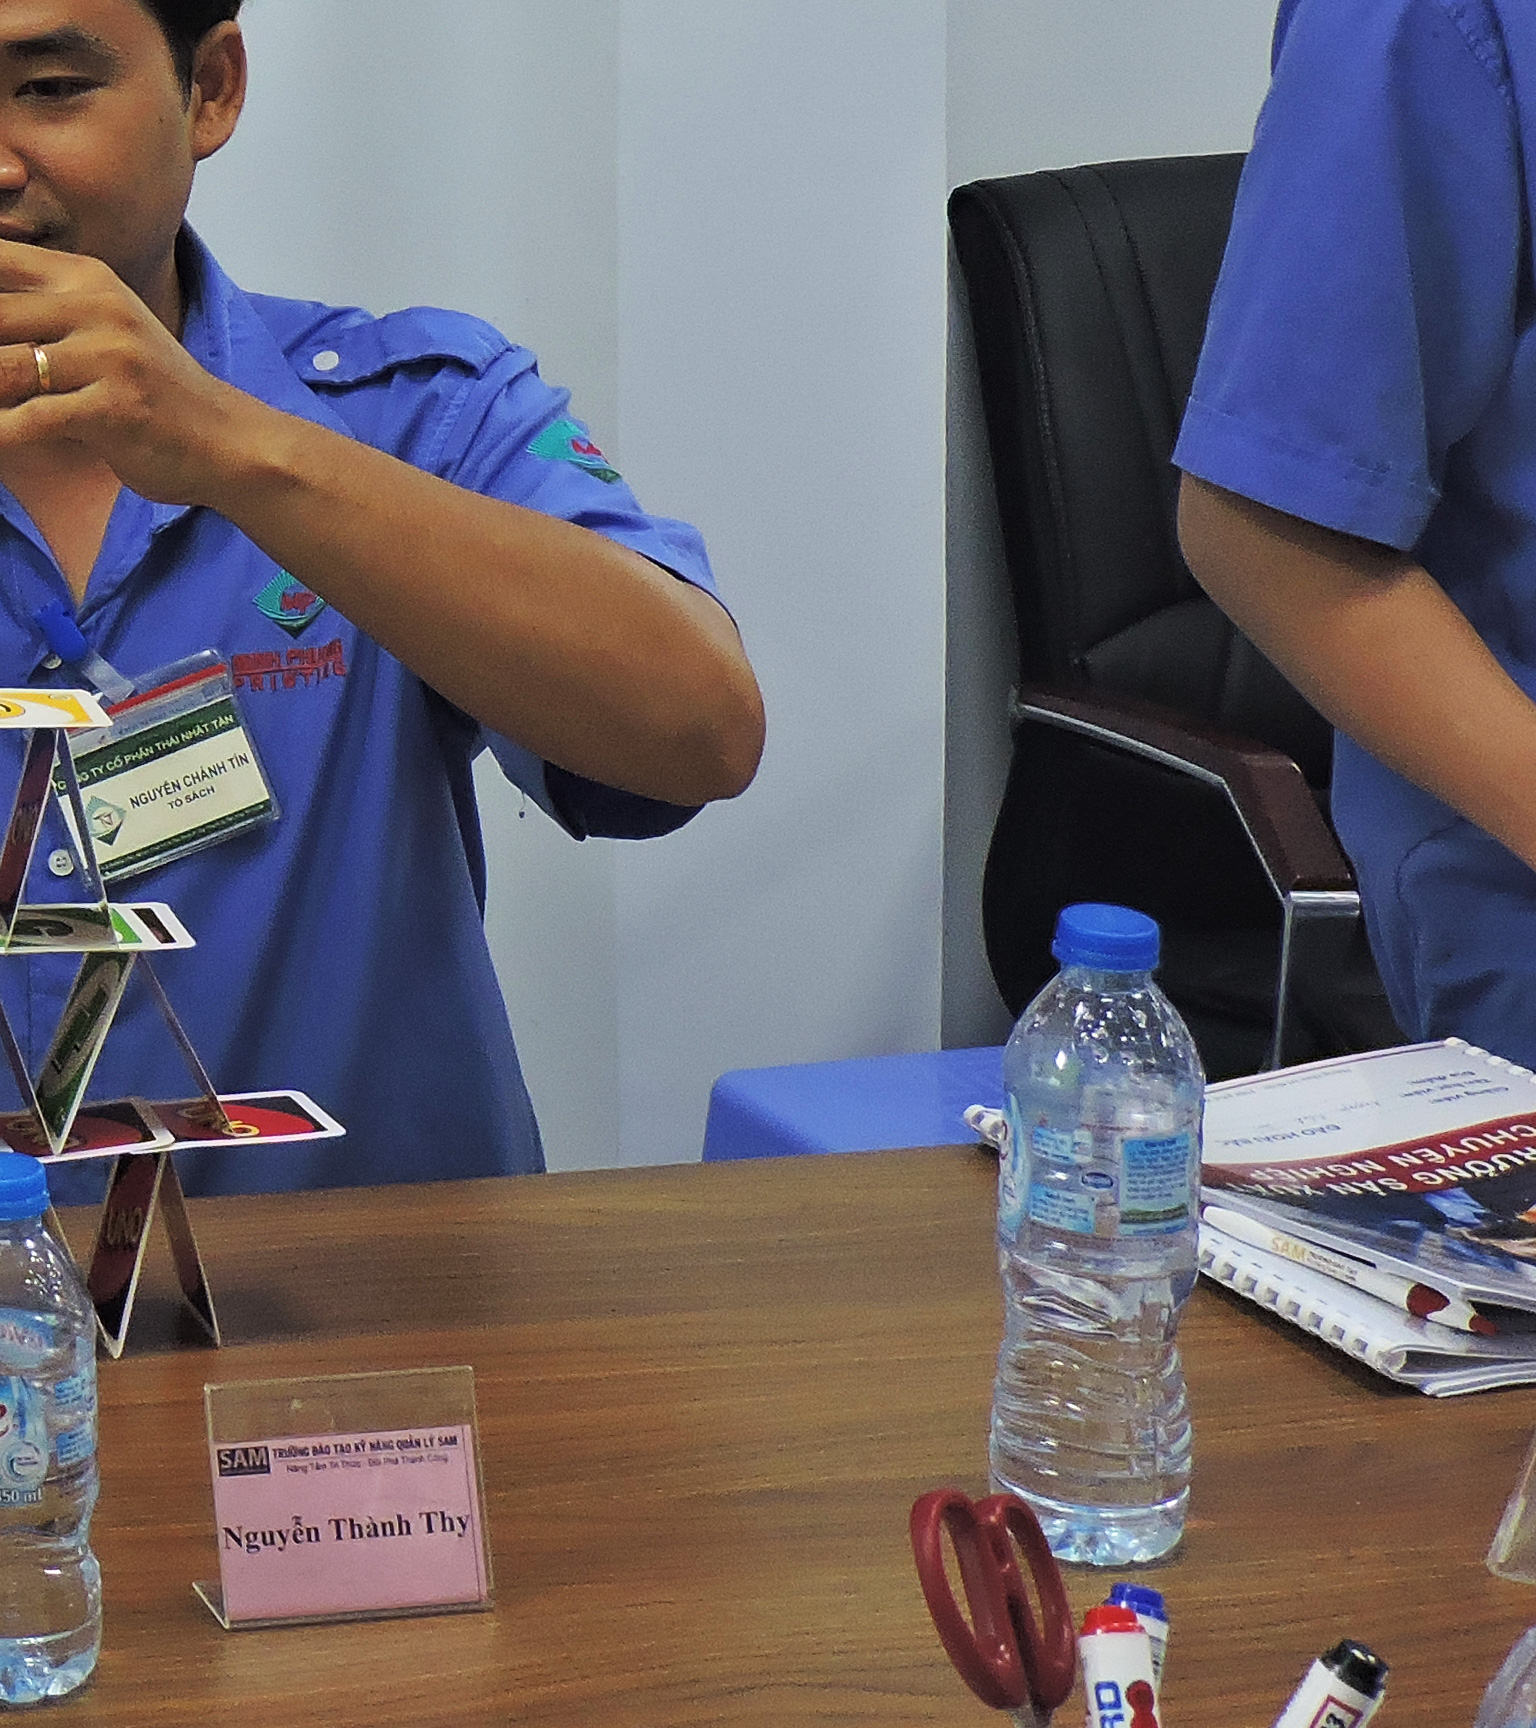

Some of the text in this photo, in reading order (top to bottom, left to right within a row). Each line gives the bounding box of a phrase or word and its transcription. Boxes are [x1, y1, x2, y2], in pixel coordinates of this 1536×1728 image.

[91, 764, 104, 778] TY
[1250, 1123, 1536, 1182] CHUYÊN NGHIỆP
[1326, 1176, 1408, 1198] SẢN
[1272, 1237, 1308, 1262] SAM
[438, 1435, 458, 1447] SAM
[218, 1448, 270, 1469] SAM
[23, 1487, 43, 1502] ml
[222, 1511, 470, 1554] Nguyễn Thành Thy
